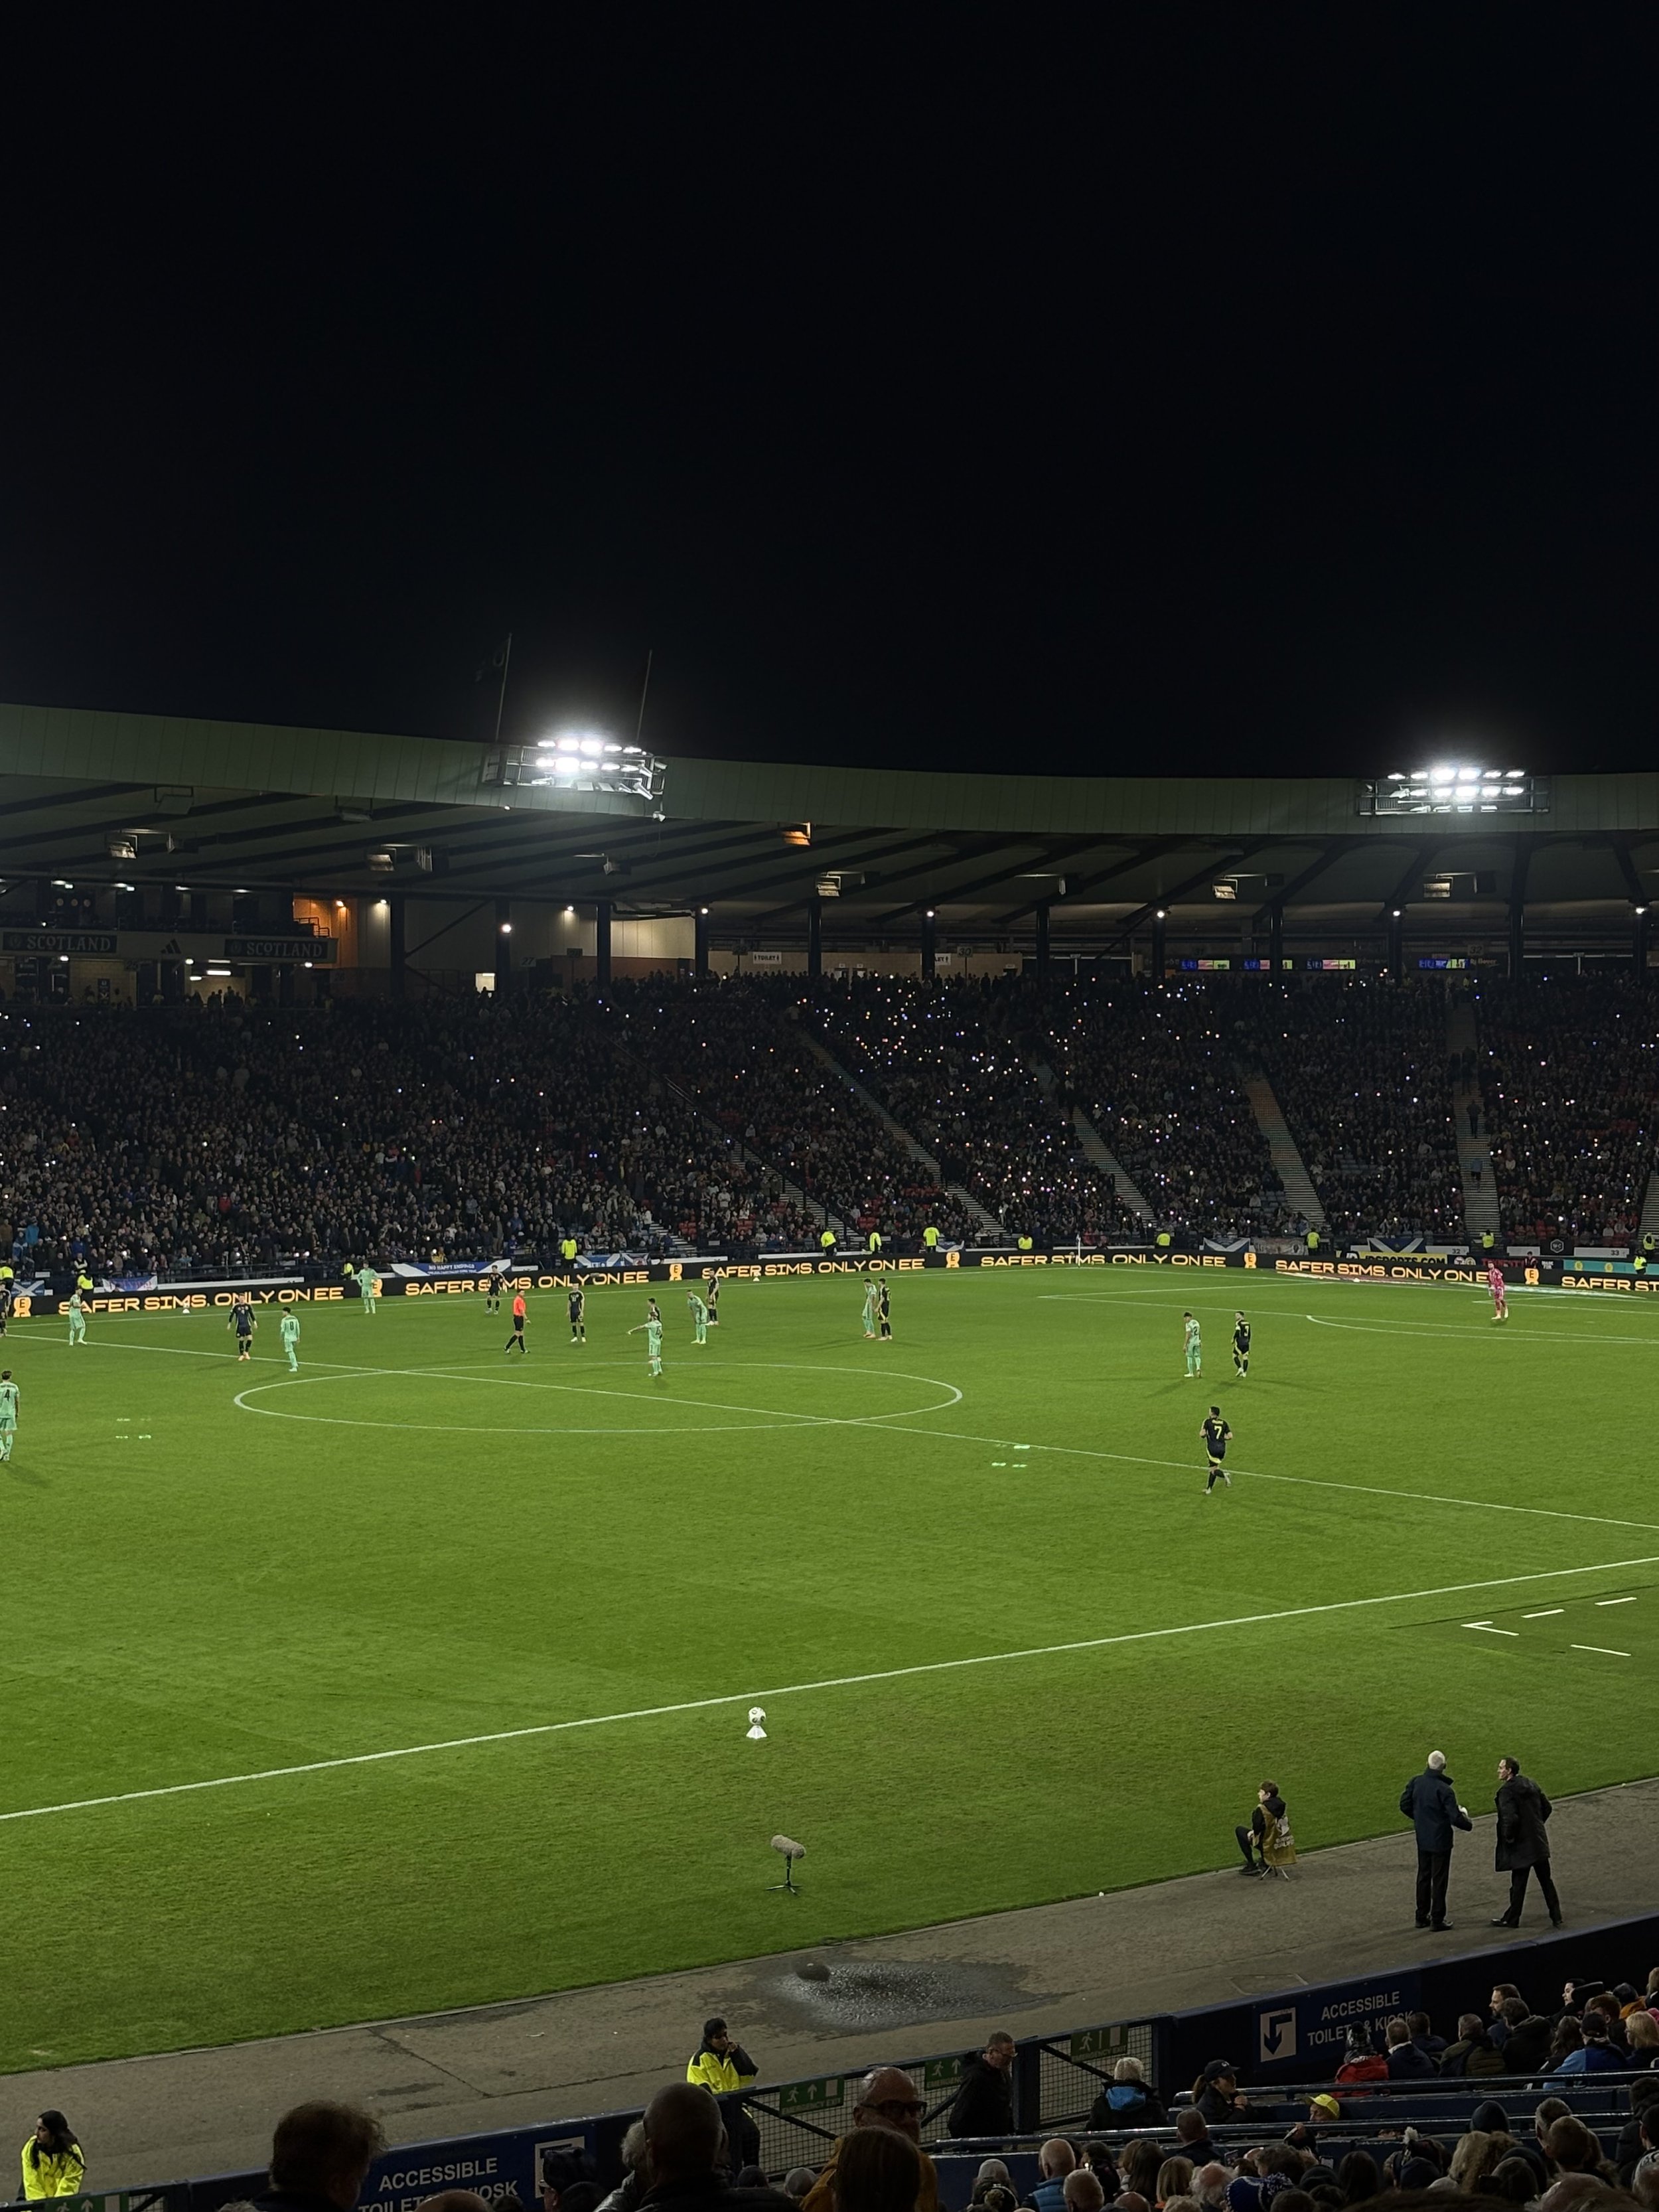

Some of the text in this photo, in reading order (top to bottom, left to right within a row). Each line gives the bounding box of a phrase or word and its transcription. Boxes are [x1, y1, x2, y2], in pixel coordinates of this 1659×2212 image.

[27, 934, 111, 952] SCOTLAND
[247, 942, 323, 958] SCOTLAND
[959, 948, 971, 956] 30
[522, 957, 534, 966] 27
[701, 1258, 925, 1280] SAFER SIMS. ONLY ON EE
[981, 1256, 1048, 1267] SAFER
[1112, 1254, 1168, 1264] ONLY
[1171, 1254, 1200, 1266] ON
[1202, 1256, 1226, 1268] EE
[1275, 1260, 1334, 1274] SAFER
[1337, 1263, 1389, 1277] SIMS.
[1391, 1266, 1442, 1280] ONLY
[1444, 1269, 1473, 1282] ON
[405, 1280, 474, 1296] SAFER
[478, 1276, 535, 1293] SMS.
[538, 1274, 590, 1289] ONLY
[623, 1270, 650, 1284] EE
[1561, 1276, 1631, 1291] SAFER
[58, 1286, 344, 1316] SAFER SIMS. ONLY ON EE
[3, 1388, 11, 1402] 4
[1214, 1425, 1222, 1439] 7
[1321, 1990, 1402, 2021] ACCESSIBLE
[1307, 2024, 1353, 2046] TOILET
[378, 2157, 498, 2192] ACCESSIBLE
